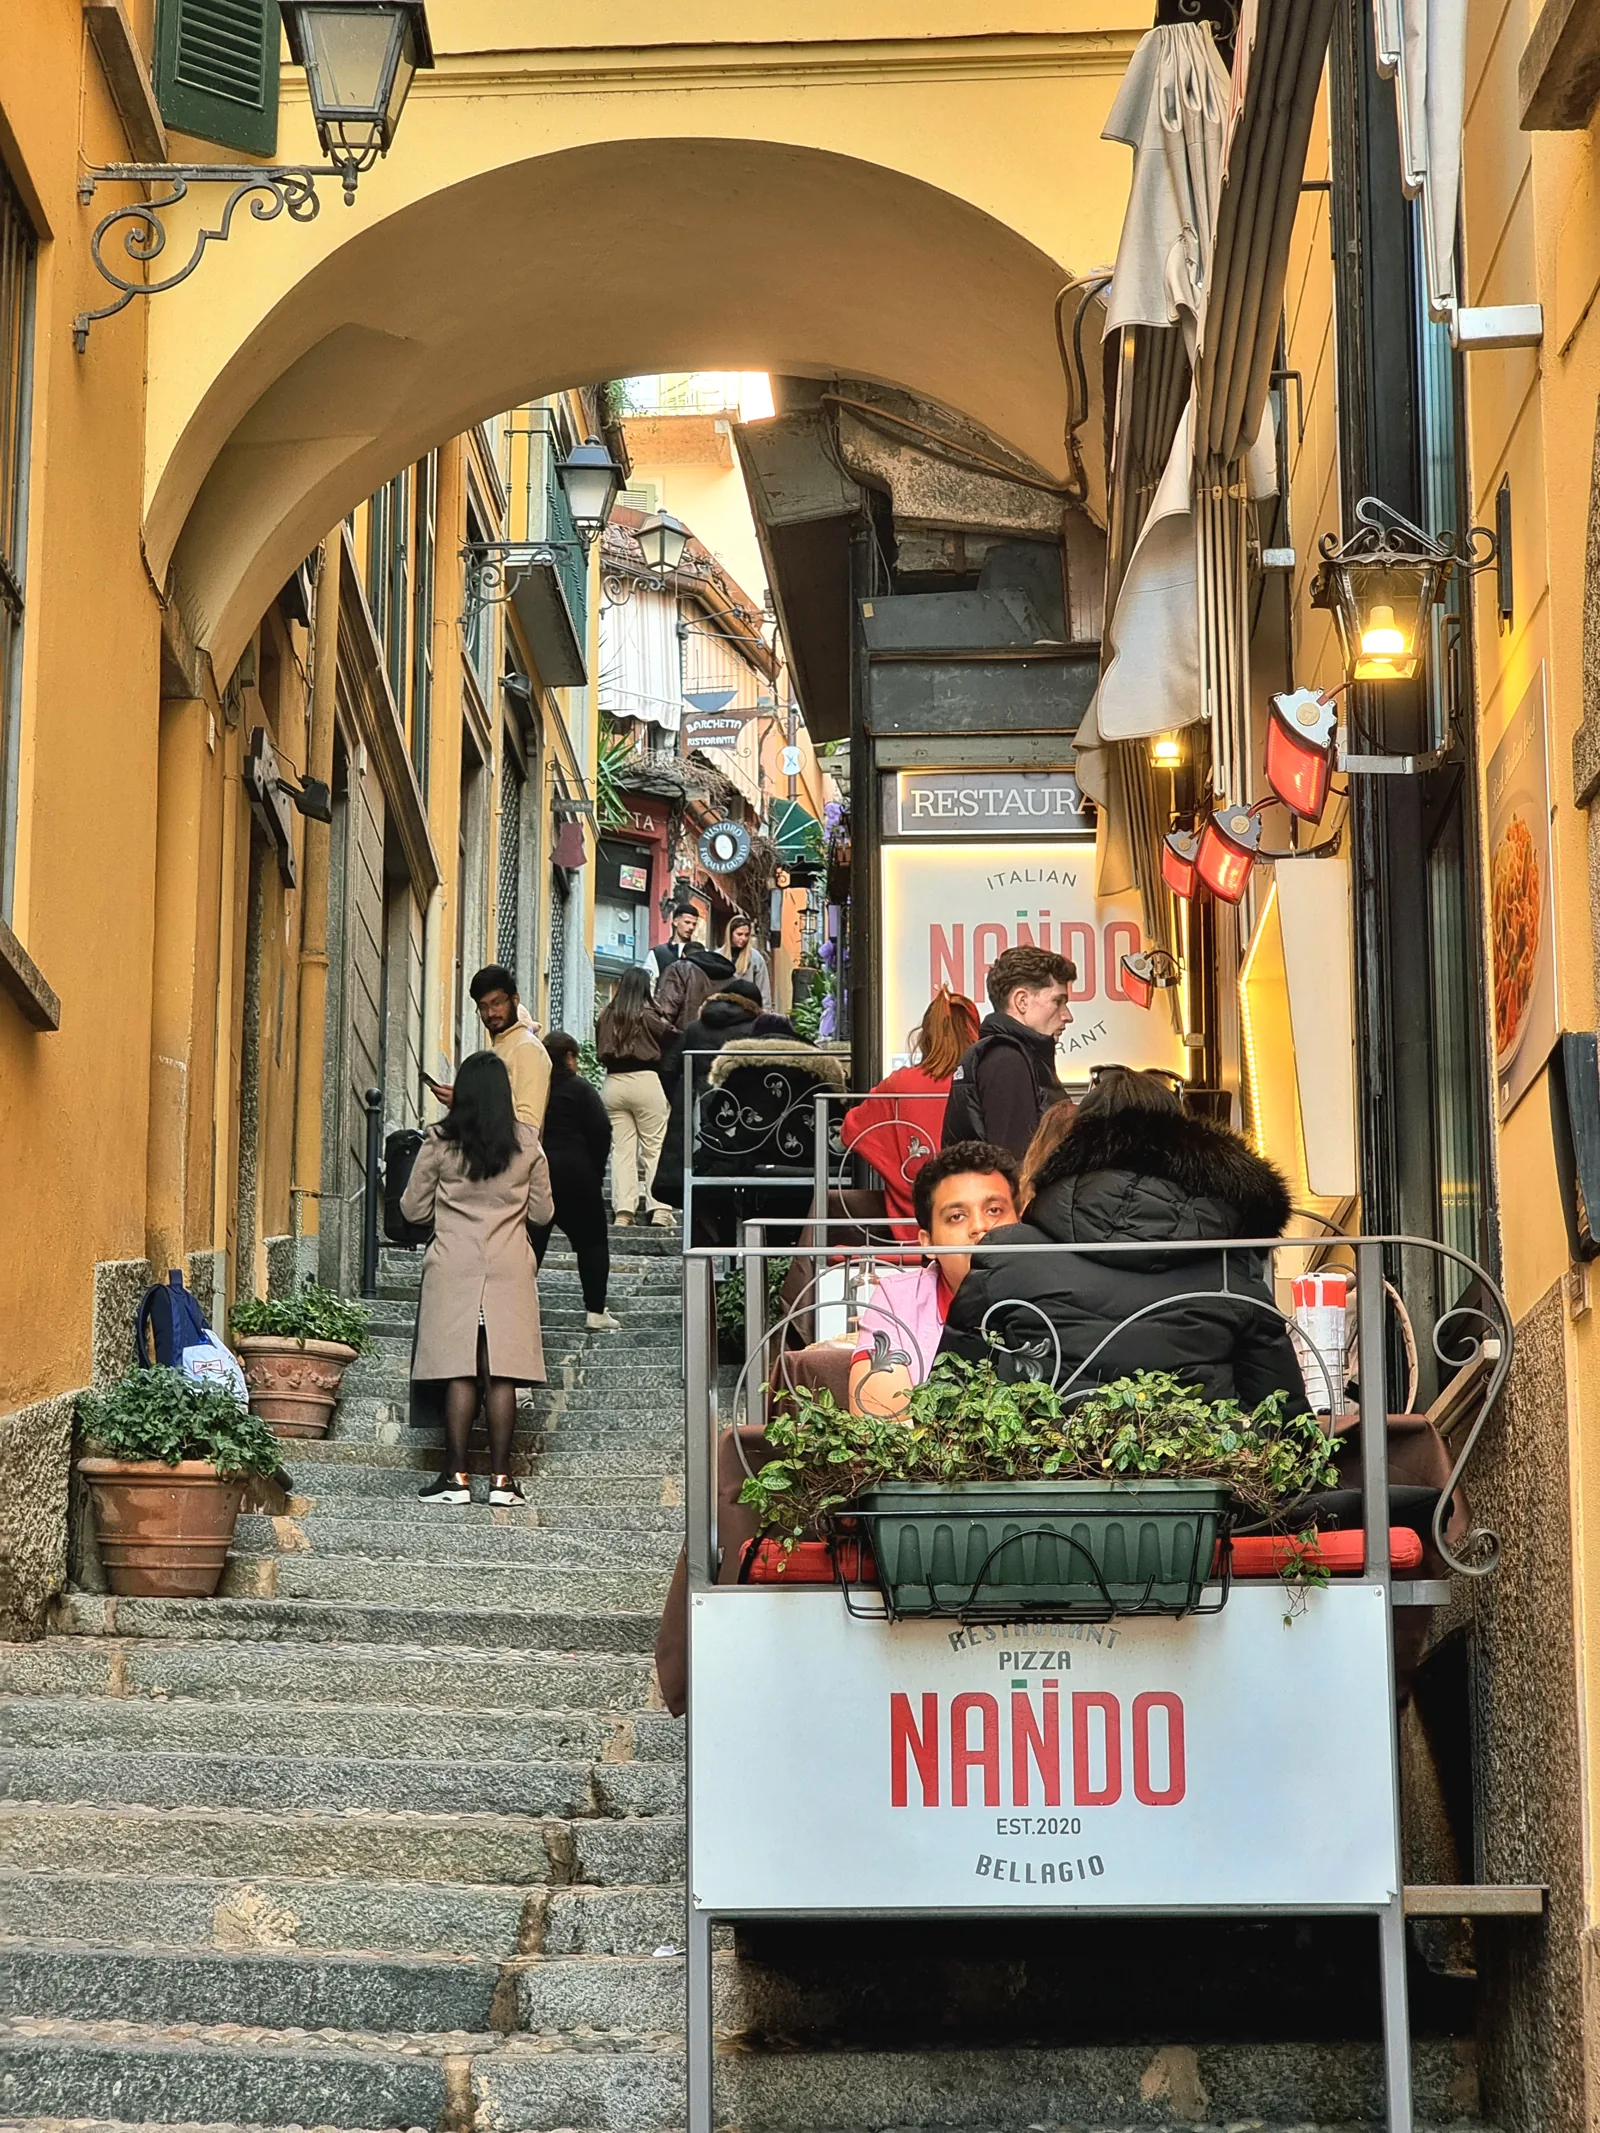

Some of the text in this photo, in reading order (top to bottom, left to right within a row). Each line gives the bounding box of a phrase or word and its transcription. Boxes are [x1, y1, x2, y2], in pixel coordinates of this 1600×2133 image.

[686, 719, 742, 734] BARCHETTA
[687, 736, 736, 746] RISTORANTE
[703, 822, 742, 840] RISTORO
[986, 868, 1077, 890] ITALIAN
[948, 1623, 1121, 1652] RESTAURANT
[999, 1650, 1072, 1670] PIZZA
[890, 1691, 1186, 1807] NANDO
[997, 1818, 1081, 1835] EST.2020
[975, 1854, 1105, 1884] BELLAGIO
